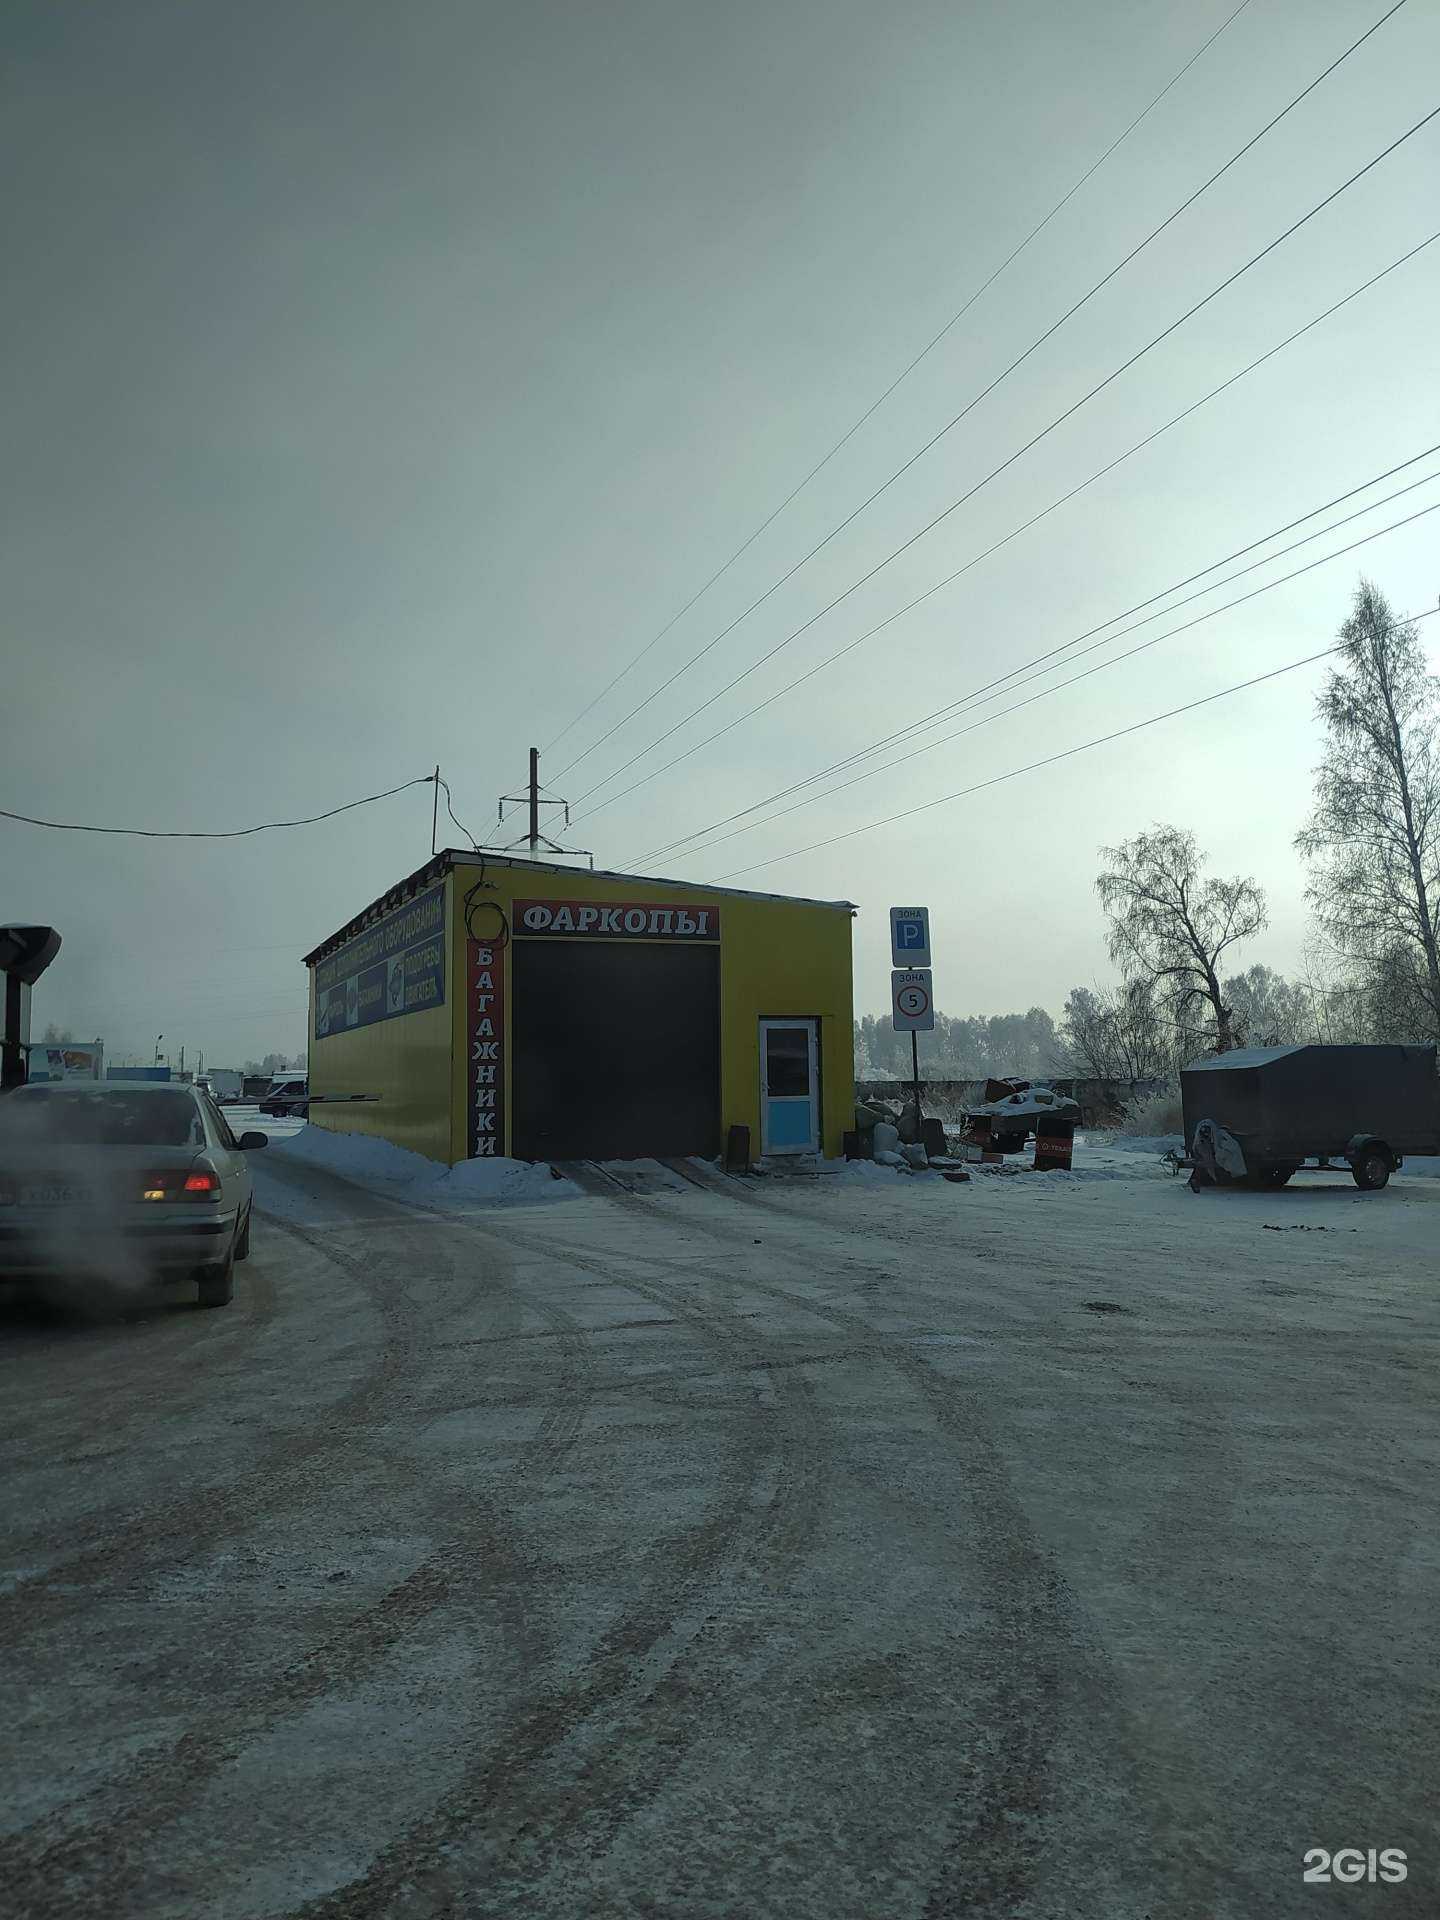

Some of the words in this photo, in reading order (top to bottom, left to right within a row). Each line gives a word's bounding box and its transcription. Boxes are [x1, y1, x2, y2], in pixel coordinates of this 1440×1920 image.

[523, 905, 709, 935] ФАРКОПЫ
[897, 910, 922, 919] ЗОНА
[903, 924, 919, 946] P
[899, 974, 925, 983] ЗОНА
[908, 994, 918, 1008] 5
[472, 948, 499, 1155] БАГАЖНИКИ
